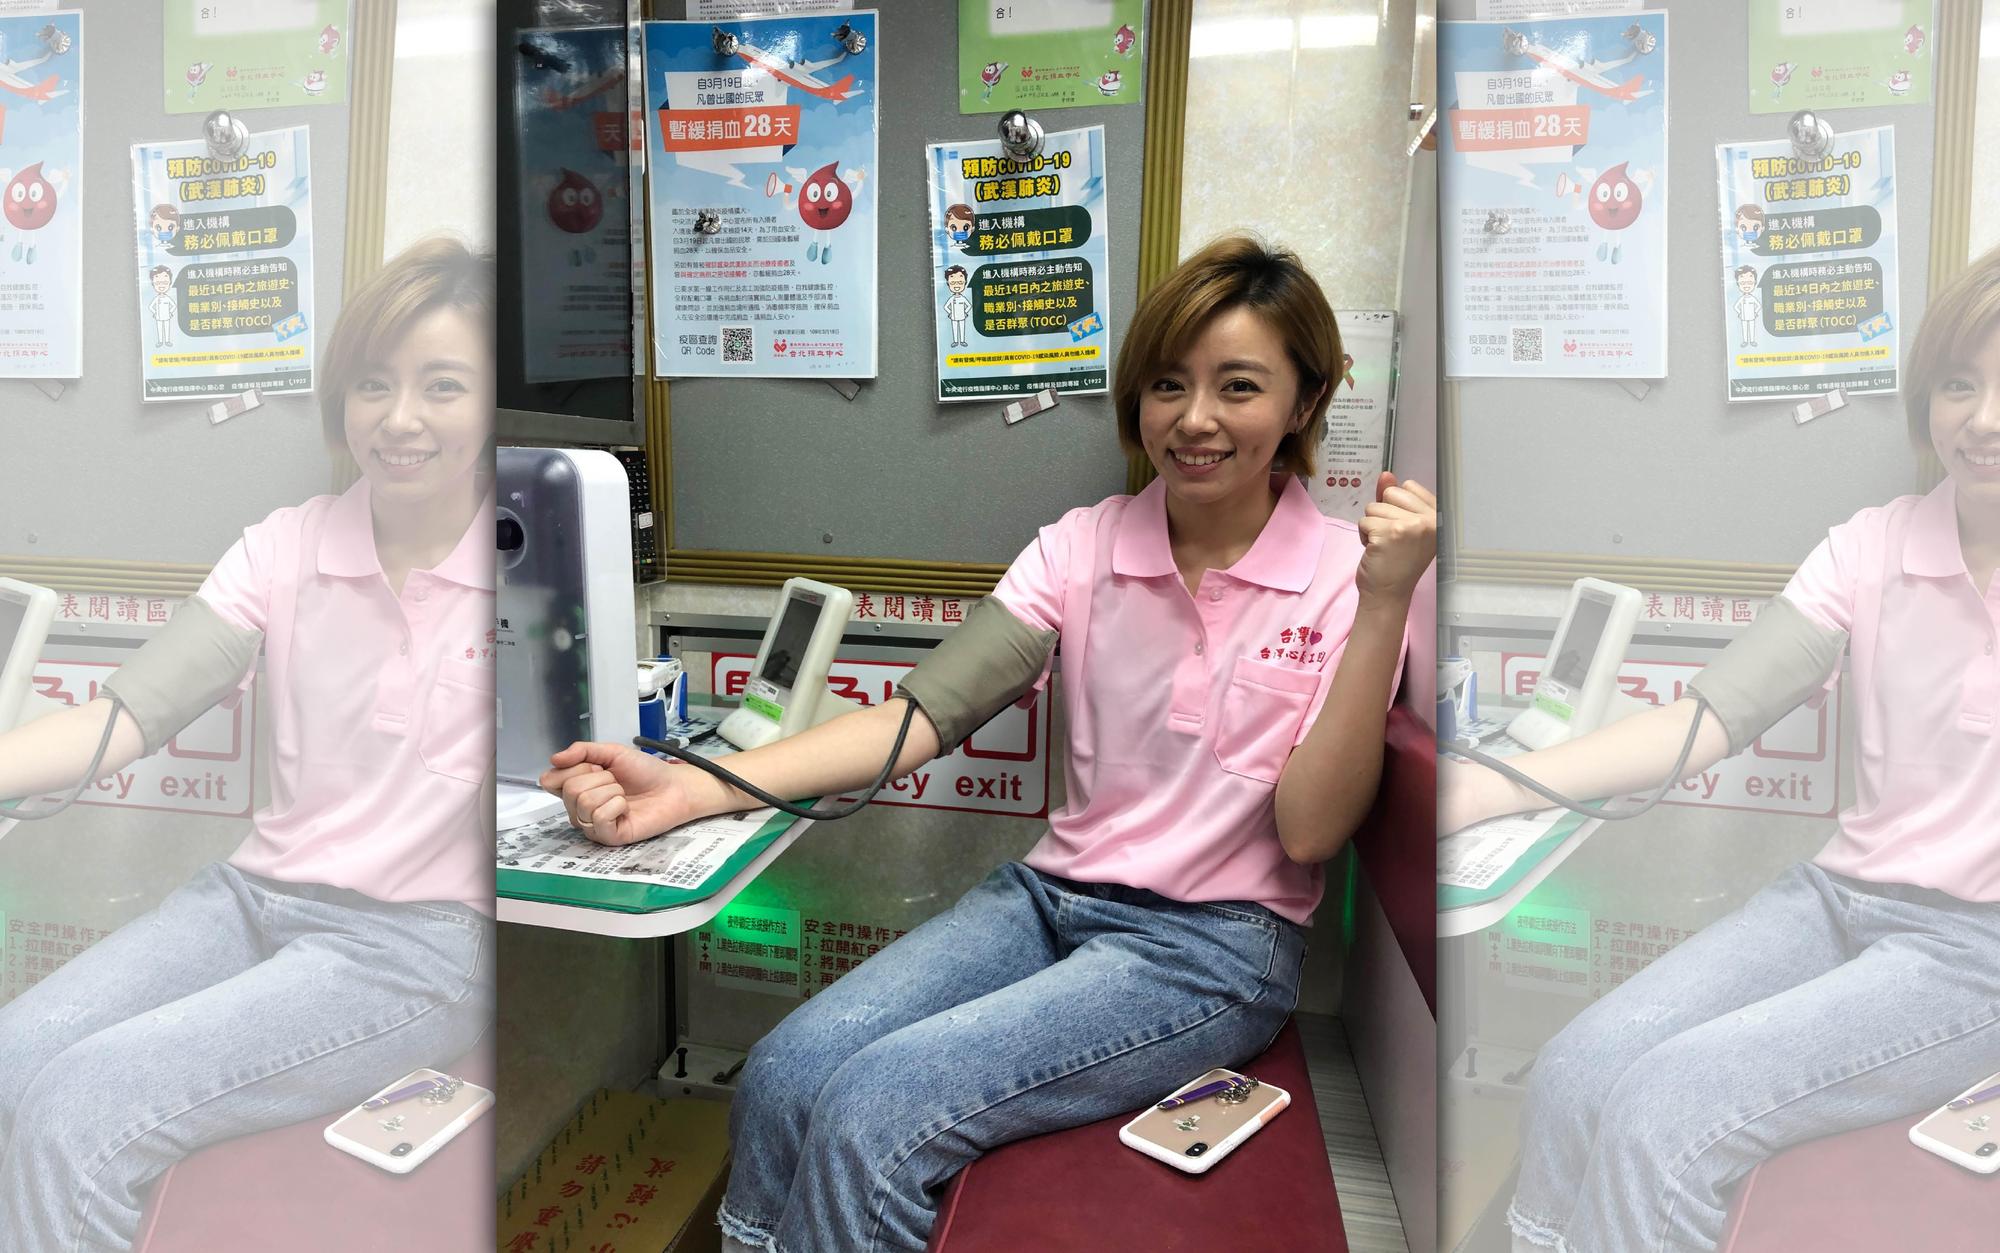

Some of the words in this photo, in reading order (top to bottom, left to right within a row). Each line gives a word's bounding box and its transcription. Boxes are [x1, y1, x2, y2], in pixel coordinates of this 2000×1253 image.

[697, 76, 759, 90] 自3月19日，
[696, 91, 764, 105] 凡曾出國的民眾
[669, 113, 792, 141] 暫緩捐血28天
[962, 151, 1072, 179] 預防COVID-19
[183, 216, 231, 231] 進入機構
[978, 216, 1026, 231] 進入機構
[1768, 216, 1816, 231] 進入機構
[979, 227, 1073, 250] 務必佩戴口罩
[982, 263, 1083, 279] 進入機構時務必主動告知
[983, 297, 1078, 313] 職業別、接觸史以及
[681, 347, 693, 355] QR
[695, 346, 716, 356] Code
[854, 593, 964, 623] 表閱讀區
[160, 771, 228, 802] exit
[955, 771, 1023, 802] exit
[1745, 771, 1813, 802] exit
[804, 971, 842, 986] 3.再
